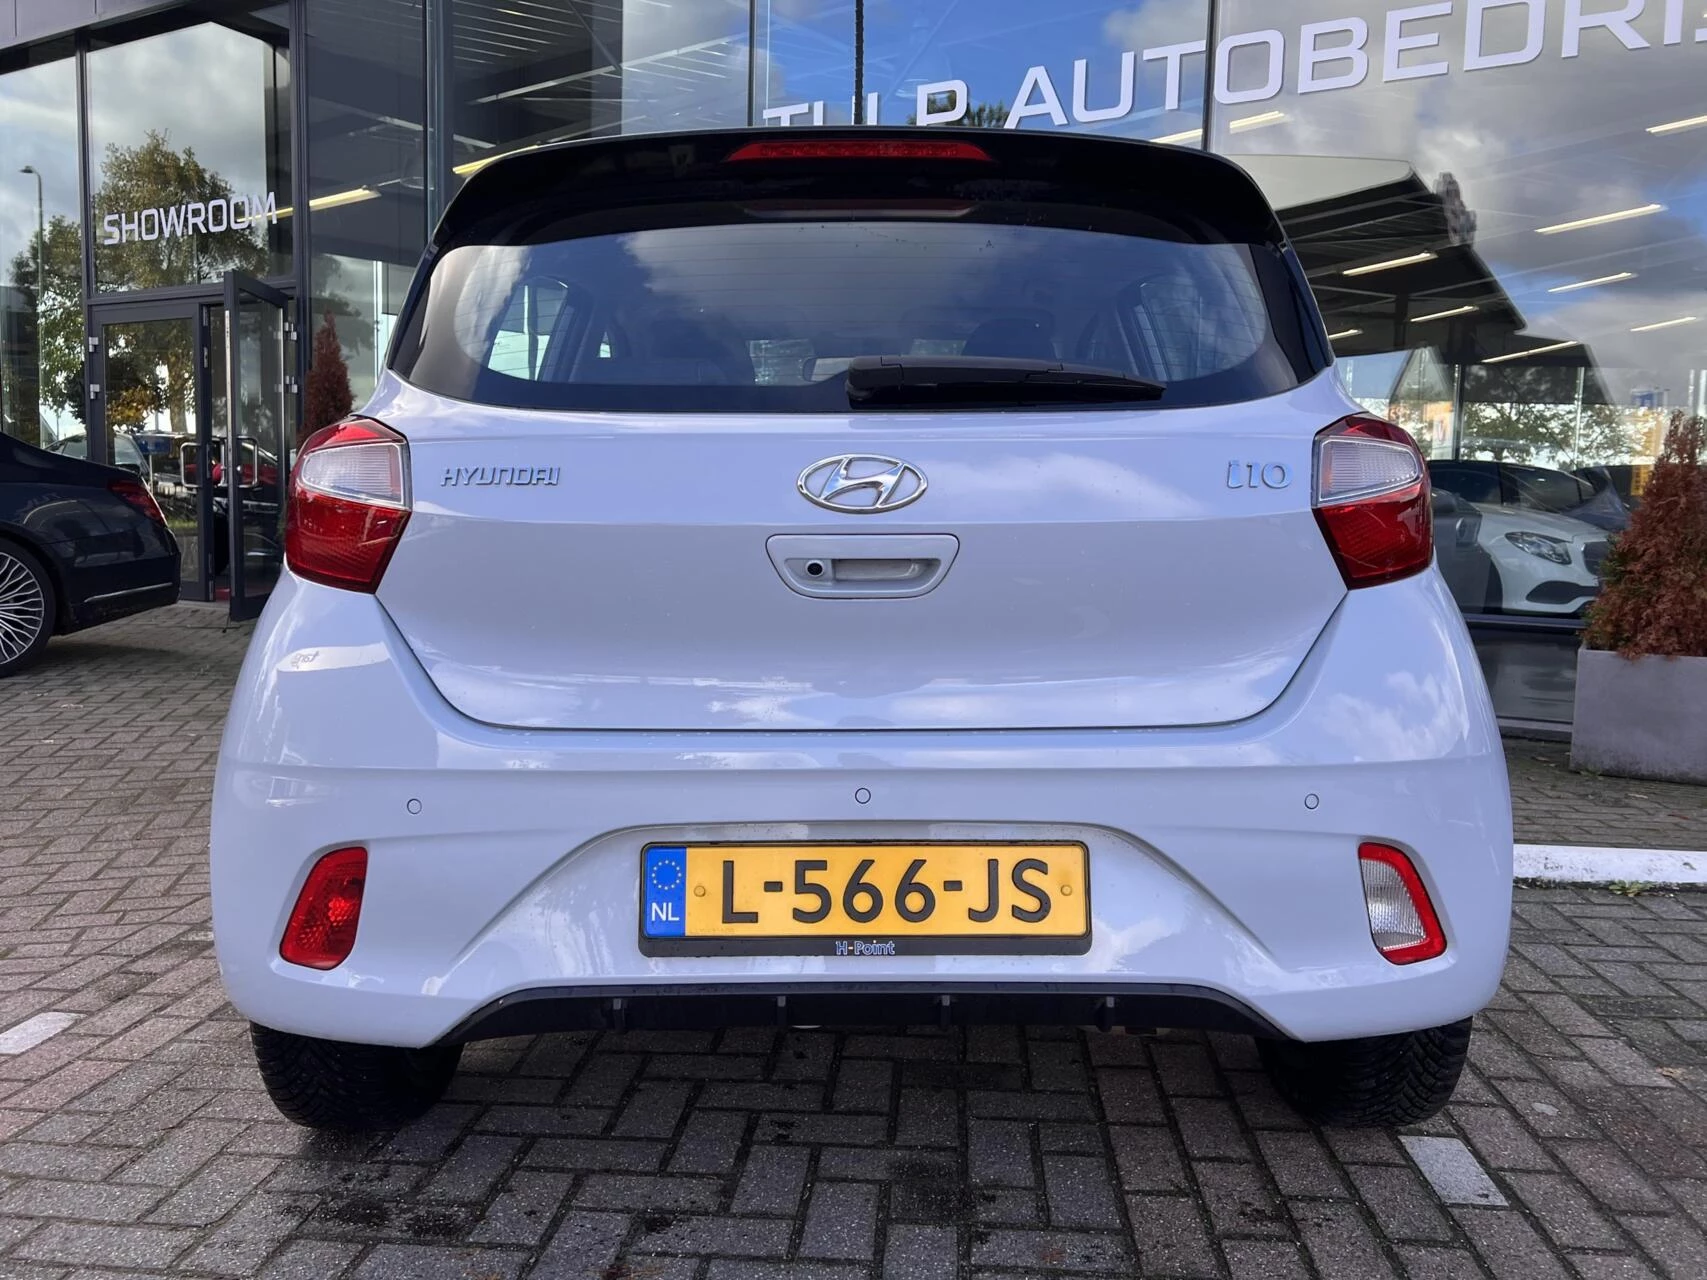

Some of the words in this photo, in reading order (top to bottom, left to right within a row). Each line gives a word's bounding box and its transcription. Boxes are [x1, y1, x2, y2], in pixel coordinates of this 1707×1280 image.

[1003, 0, 1707, 129] AUTOBEDRI
[103, 191, 277, 246] SHOWROOM
[440, 467, 561, 486] HYUNDAI
[722, 859, 1052, 924] L-566-JS
[650, 903, 680, 922] NL
[835, 939, 896, 956] H-Point
